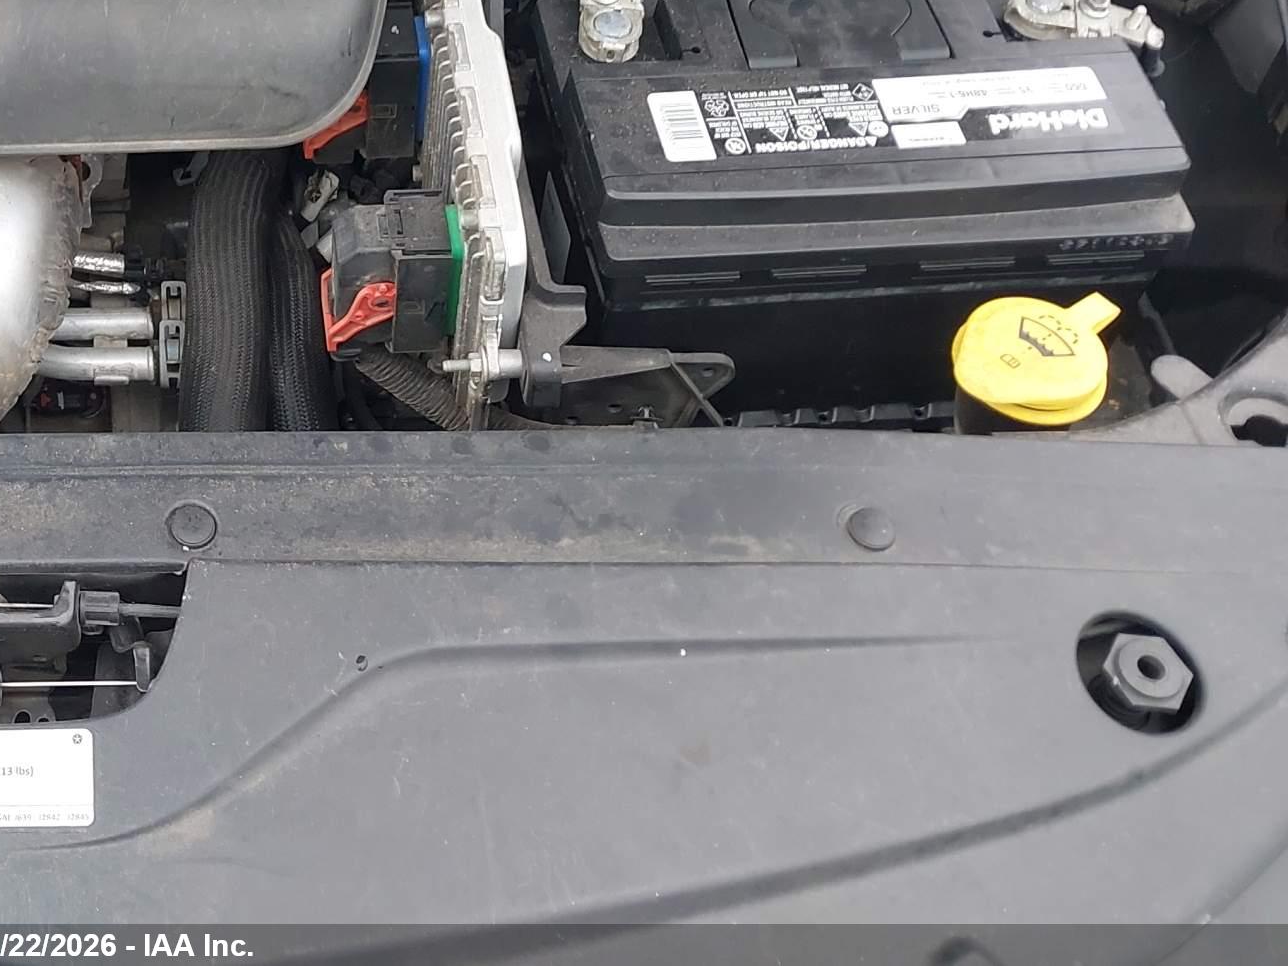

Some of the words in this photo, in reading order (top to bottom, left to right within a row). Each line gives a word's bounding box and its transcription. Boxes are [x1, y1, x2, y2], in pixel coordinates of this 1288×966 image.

[891, 103, 941, 116] SILVER
[987, 107, 1109, 135] DieHard
[755, 136, 866, 153] DANGER/POISON
[15, 766, 35, 778] lbs)
